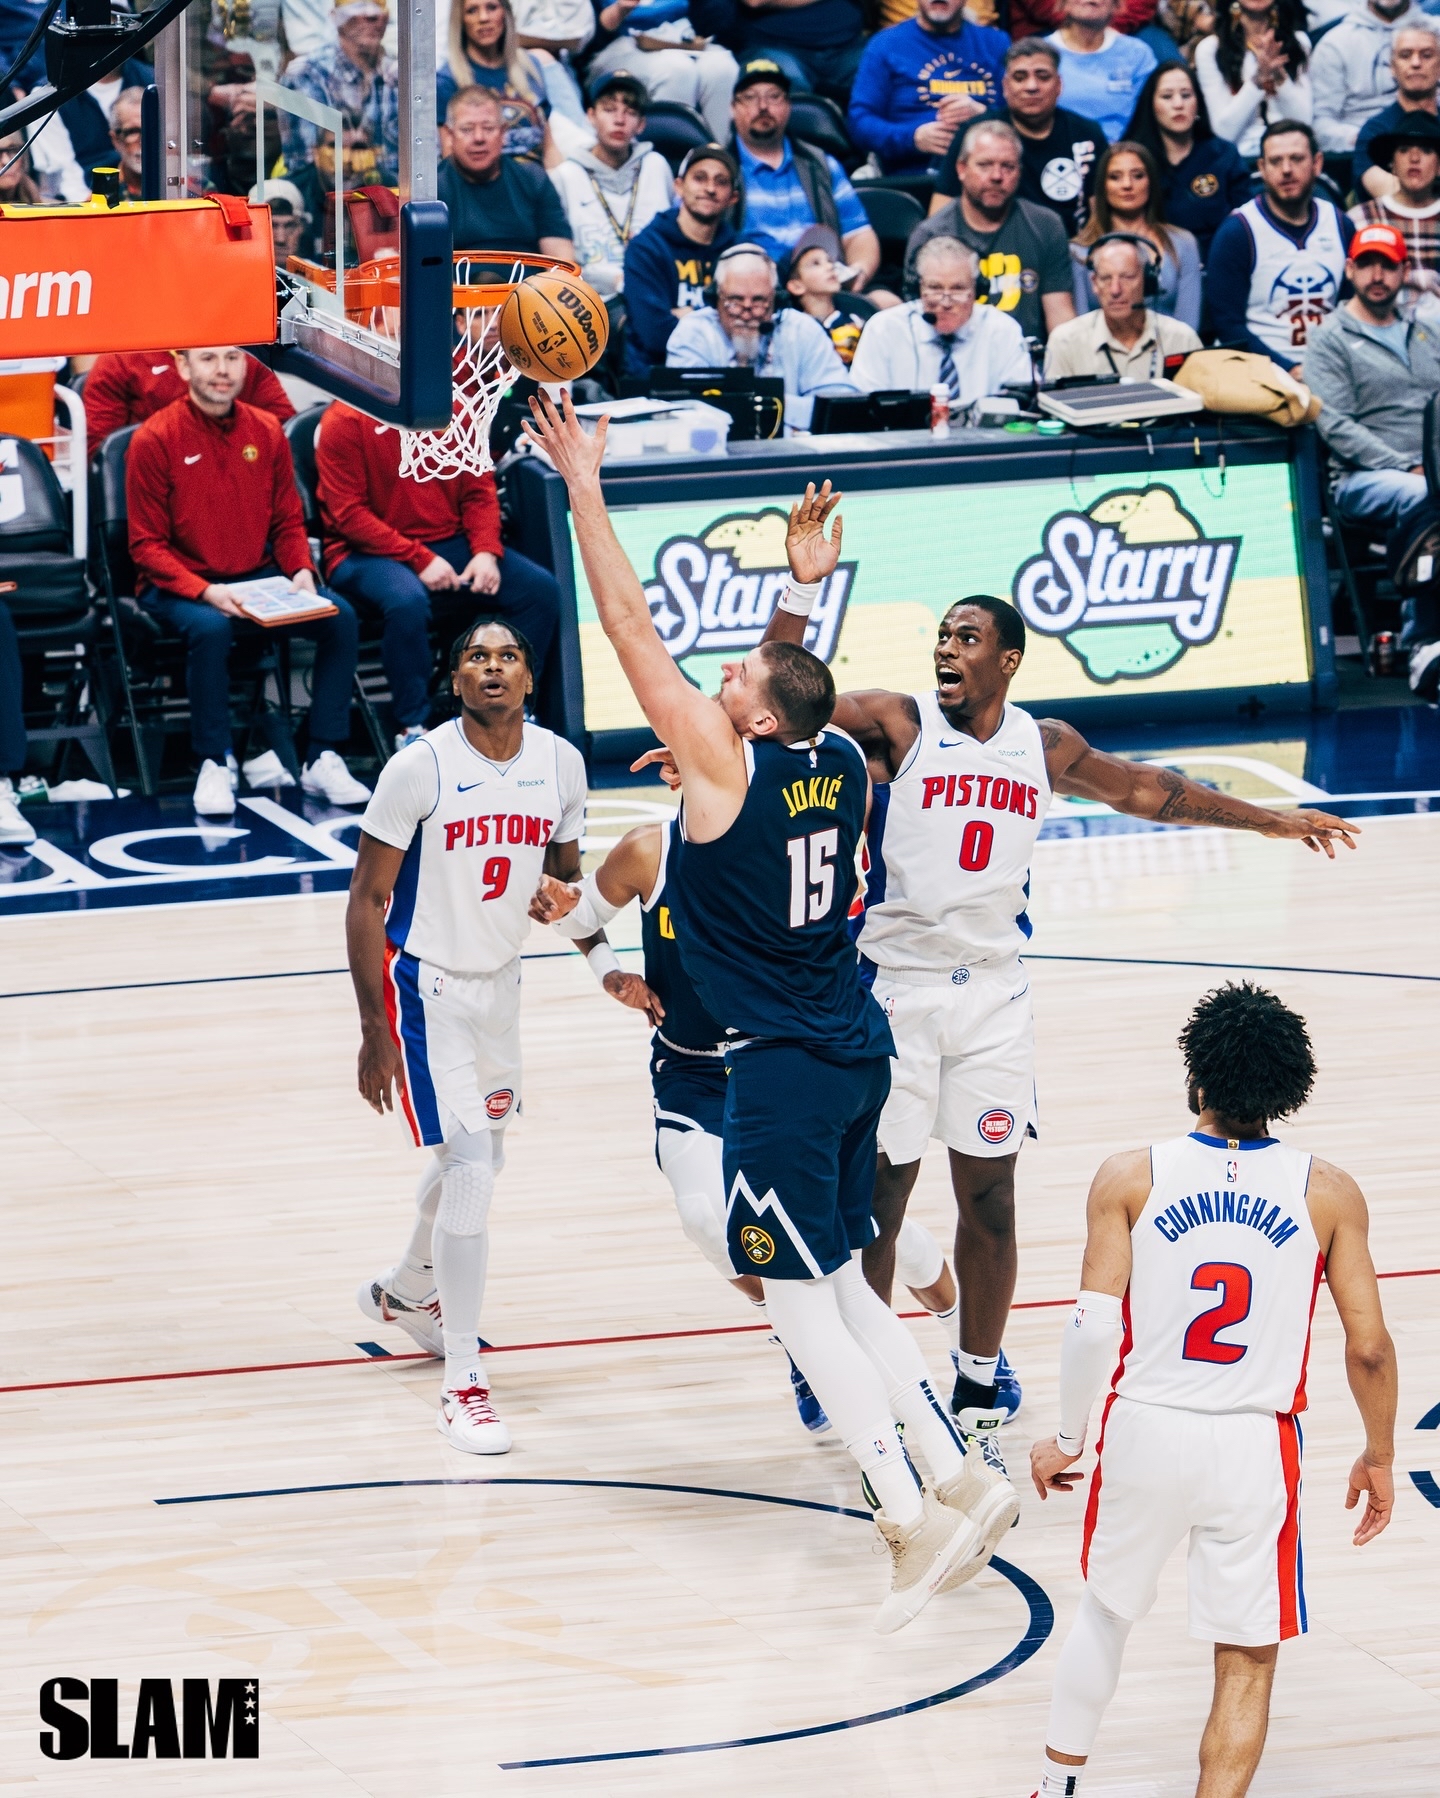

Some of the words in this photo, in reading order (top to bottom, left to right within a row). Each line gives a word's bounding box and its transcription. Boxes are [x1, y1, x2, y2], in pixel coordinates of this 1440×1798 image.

[556, 286, 599, 355] Wilson
[645, 541, 849, 663] Stary
[1018, 516, 1234, 641] Starry
[998, 749, 1027, 757] StockX
[517, 779, 545, 788] StockX
[781, 774, 844, 818] JOKIĆ
[922, 774, 1039, 820] PISTONS
[443, 814, 554, 851] PISTONS
[959, 820, 994, 872] 0
[482, 856, 511, 902] 9
[787, 826, 840, 930] 15
[1153, 1190, 1300, 1249] CUNNINGHAM
[1182, 1261, 1252, 1365] 2
